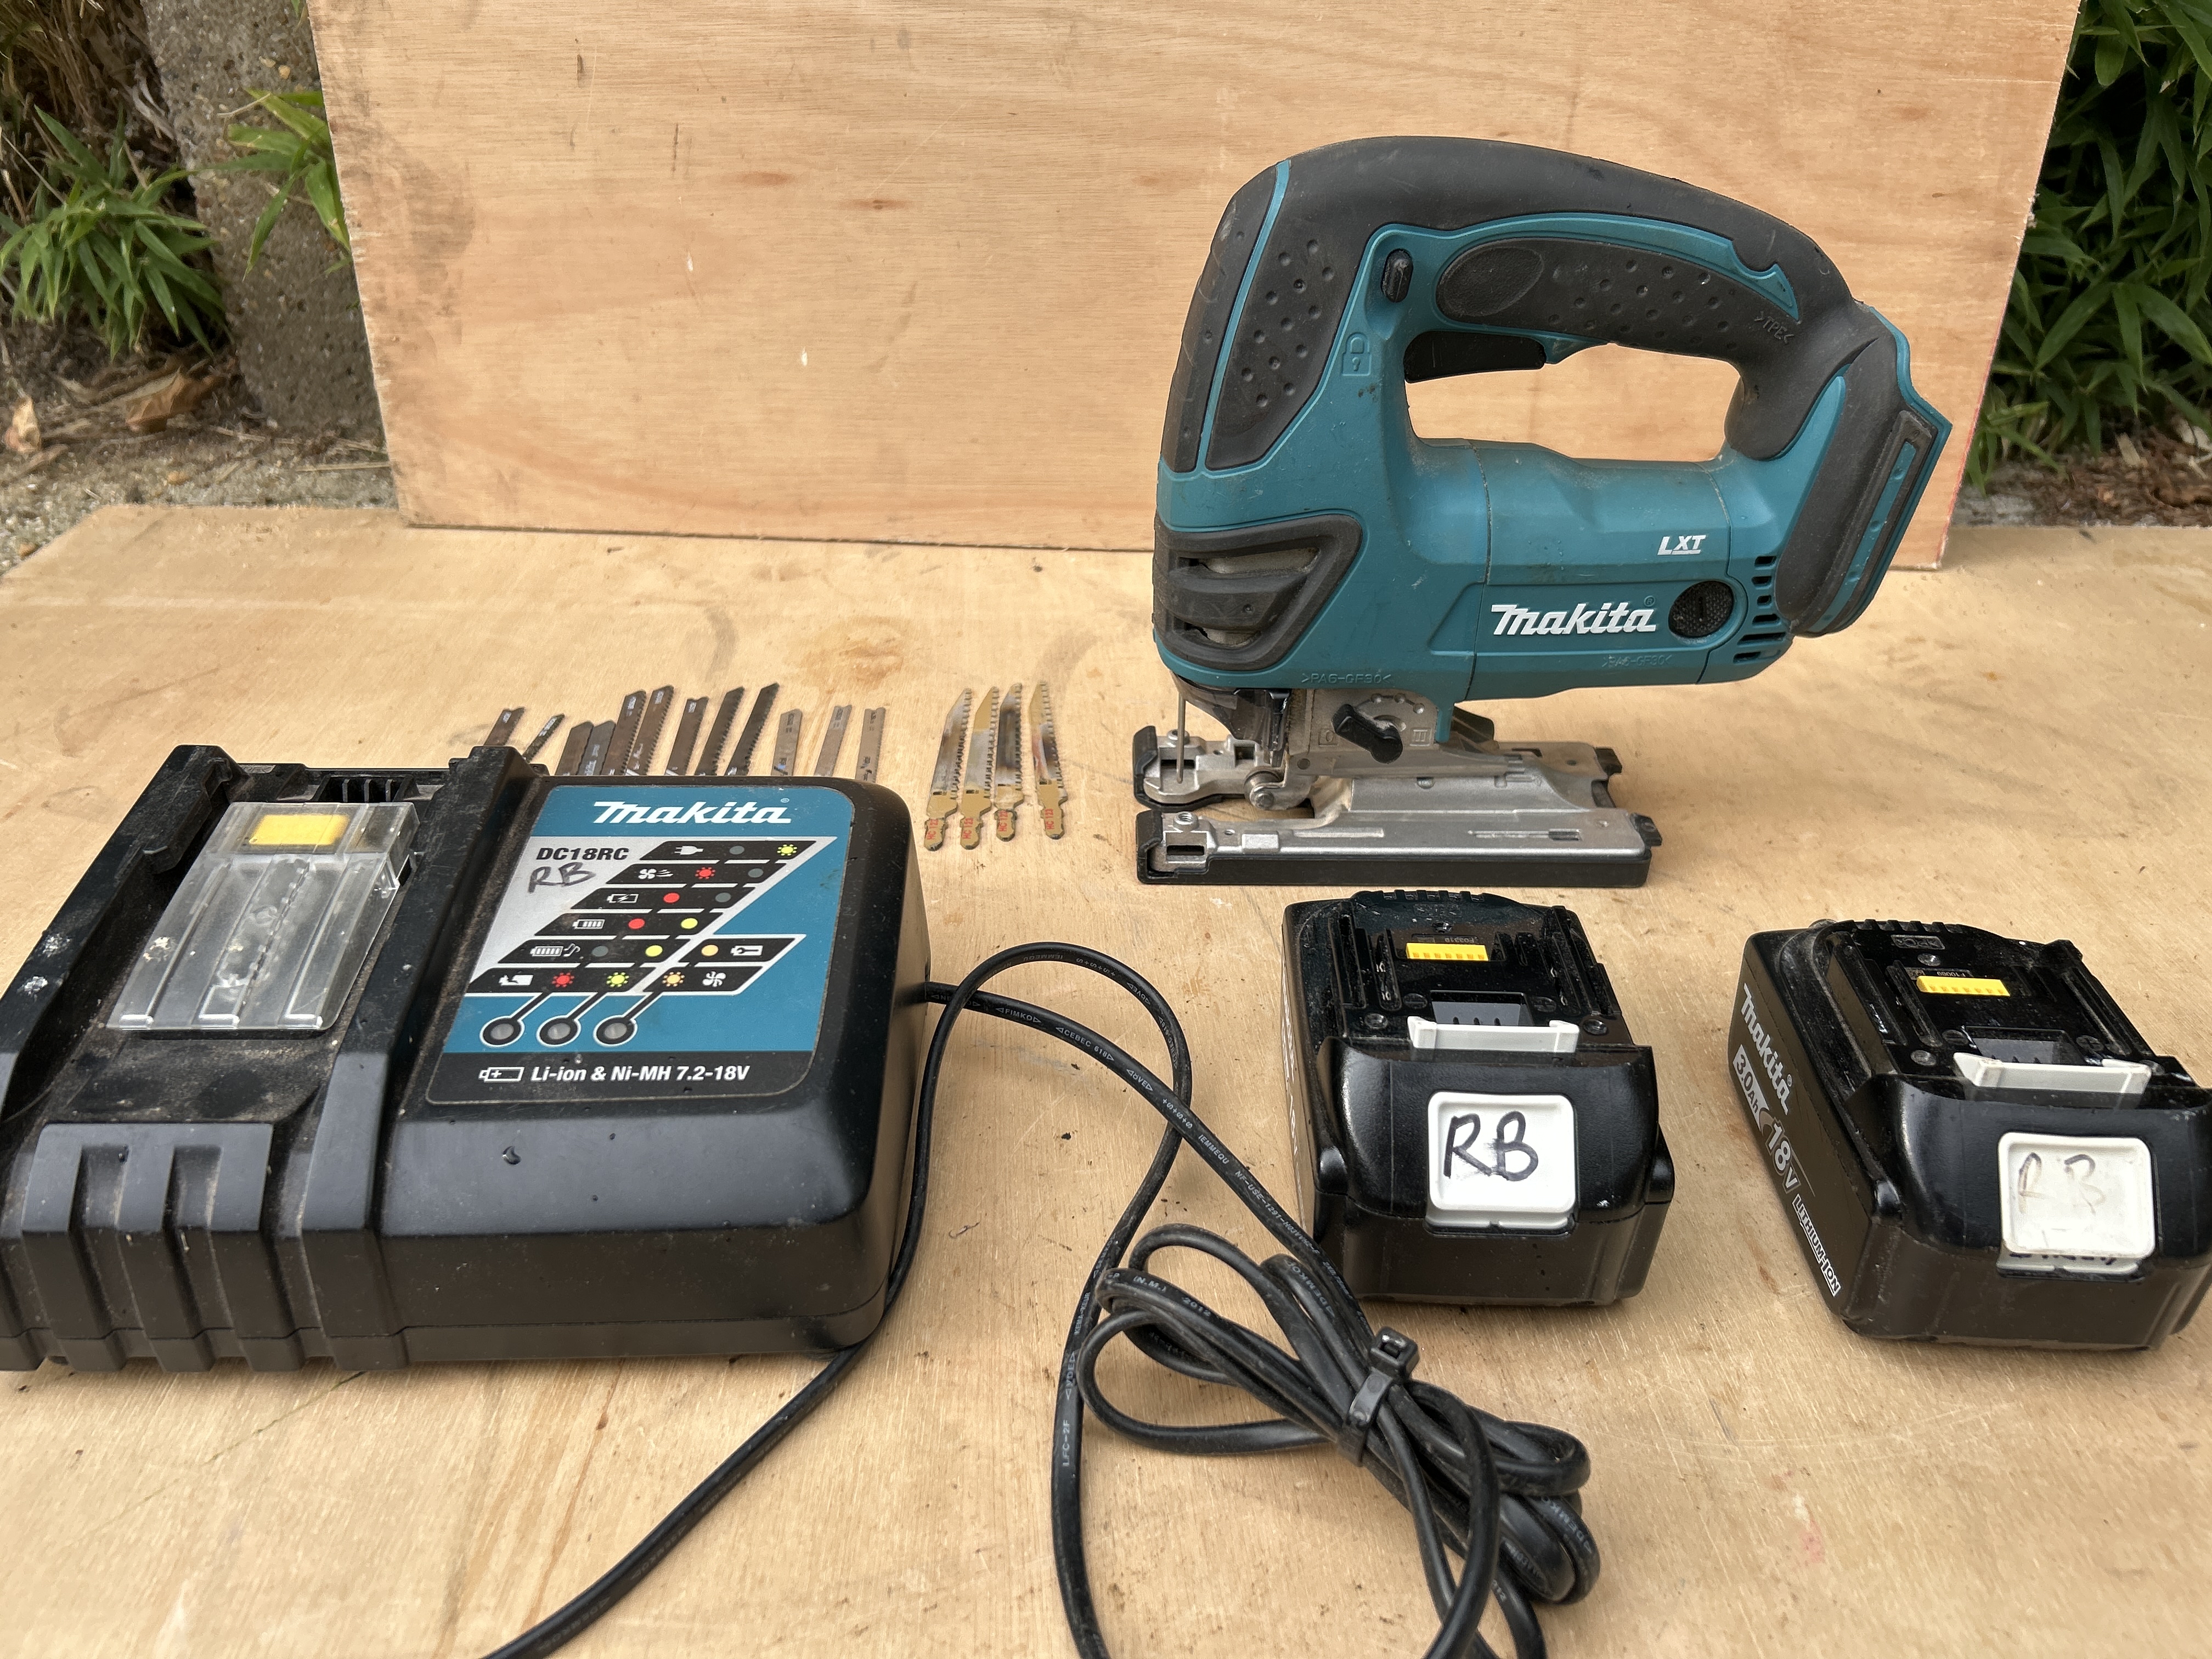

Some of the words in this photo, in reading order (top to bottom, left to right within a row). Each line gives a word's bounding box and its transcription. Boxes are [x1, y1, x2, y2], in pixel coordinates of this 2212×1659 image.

[1657, 535, 1707, 556] LXT
[528, 861, 595, 893] RB
[535, 847, 629, 861] DC18RC
[532, 1066, 586, 1081] Li-ion
[591, 1067, 606, 1081] &
[611, 1066, 669, 1081] Ni-MH
[676, 1066, 750, 1081] 7.2-18V
[1063, 1029, 1091, 1046] CEBEC
[1198, 1135, 1229, 1164] IEMMEQU
[1736, 1054, 1759, 1113] 3.0Ah
[1443, 1111, 1539, 1182] RB
[1769, 1124, 1798, 1188] 18V
[1793, 1196, 1840, 1293] LITHIUM-ION
